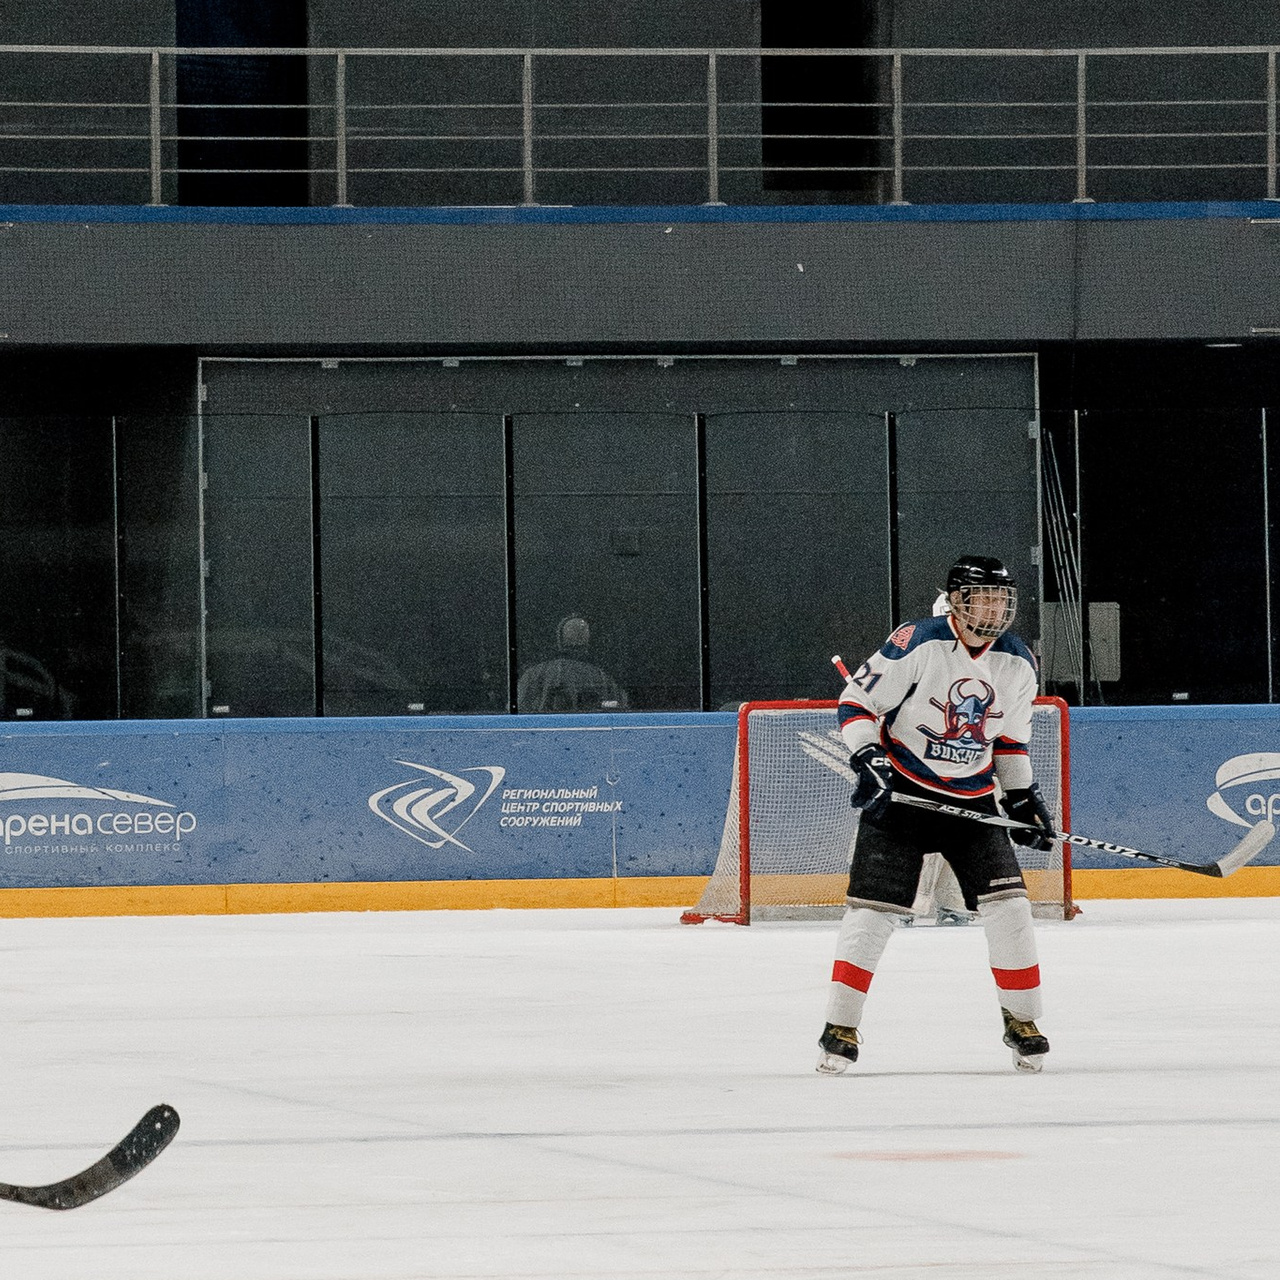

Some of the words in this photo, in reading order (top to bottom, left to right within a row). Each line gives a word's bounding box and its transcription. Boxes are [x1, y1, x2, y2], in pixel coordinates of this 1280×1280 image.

[853, 662, 883, 694] 21
[502, 786, 598, 800] РЕГИОНАЛЬНЫЙ
[501, 801, 539, 814] ЦЕНТР
[542, 800, 623, 813] СПОРТИВНЫХ
[499, 813, 582, 827] СООРУЖЕНИЙ
[5, 843, 100, 855] СПОРТИВНЫЙ
[106, 841, 181, 853] КОМПЛЕКС
